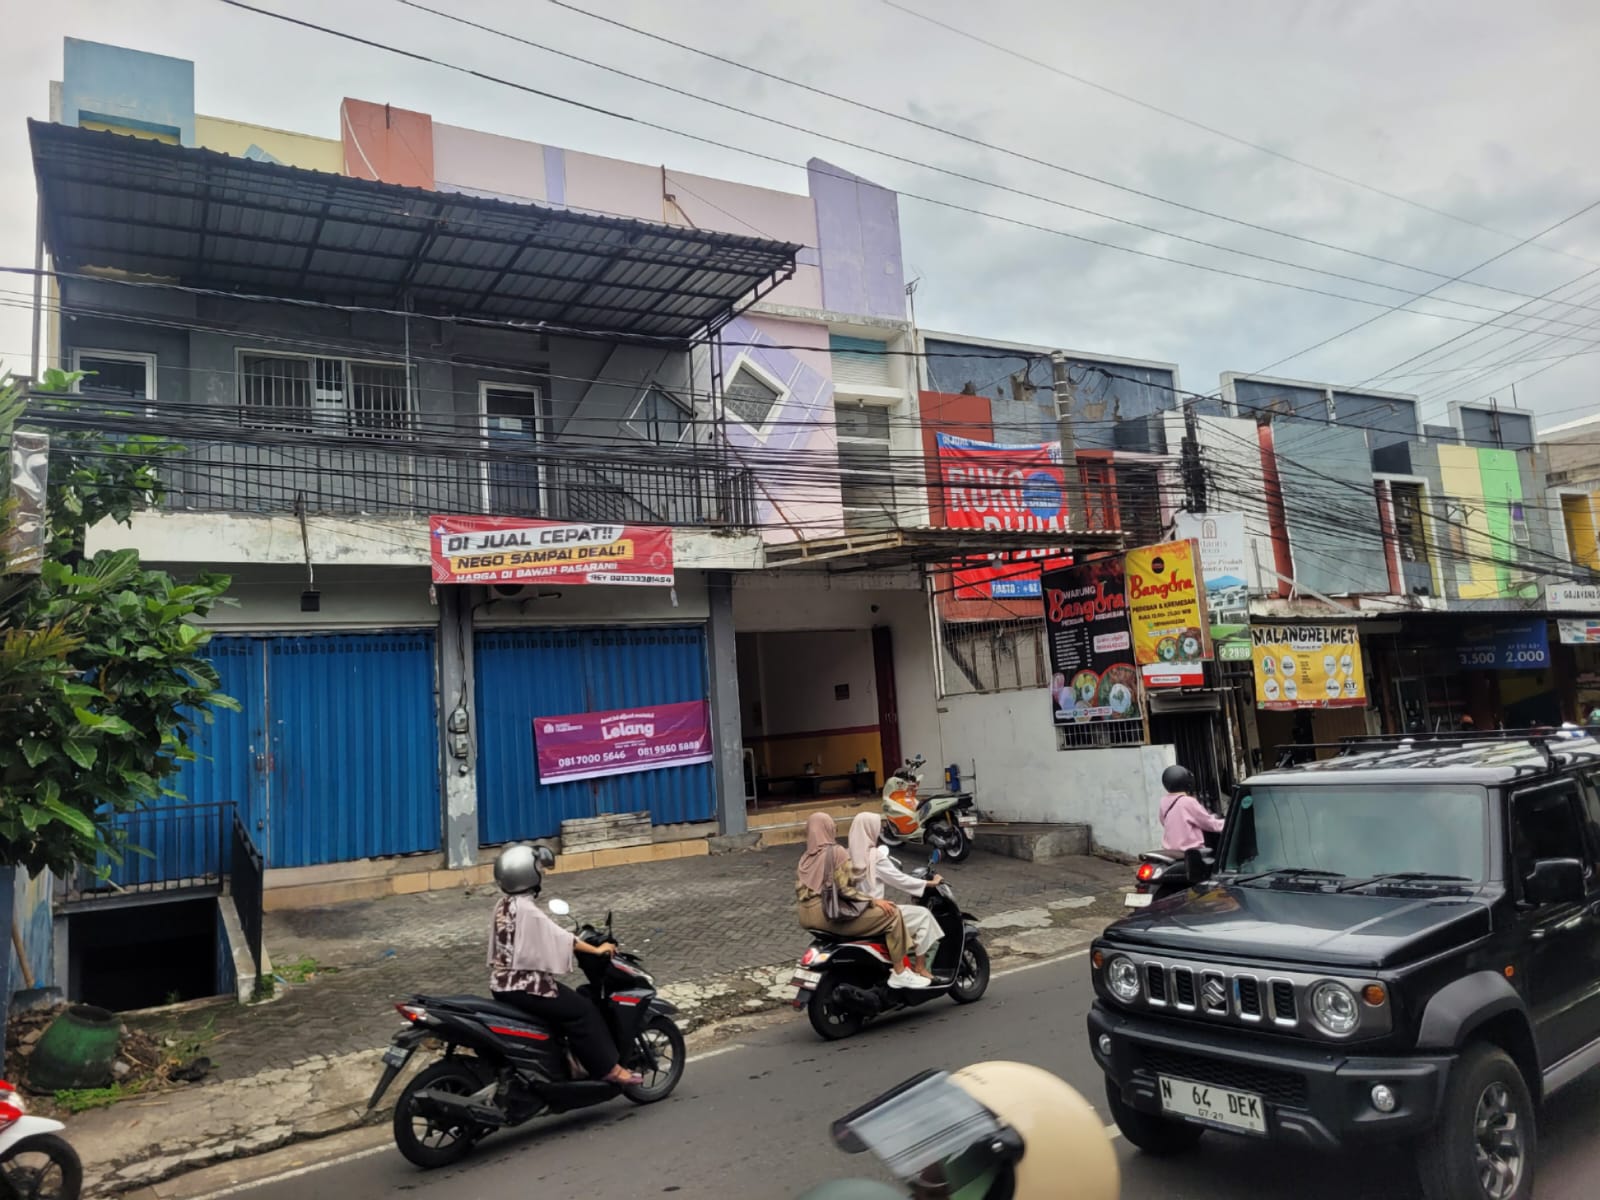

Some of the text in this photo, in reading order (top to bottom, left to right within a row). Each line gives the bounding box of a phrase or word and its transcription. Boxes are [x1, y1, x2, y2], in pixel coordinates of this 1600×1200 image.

[947, 467, 1027, 513] RUKO
[447, 526, 614, 553] DI JUAL CEPAT!!
[457, 545, 626, 570] NEGO SAMPAI DEAL!!
[456, 571, 498, 582] HARGA
[501, 570, 514, 580] DI
[516, 566, 558, 578] BAWAH
[1063, 586, 1097, 600] WARUNG
[1458, 650, 1545, 665] 3.500 2.000
[601, 722, 655, 740] Lelang
[558, 757, 576, 768] 081
[577, 754, 601, 766] 7000
[1161, 1079, 1261, 1119] N 64 DEK
